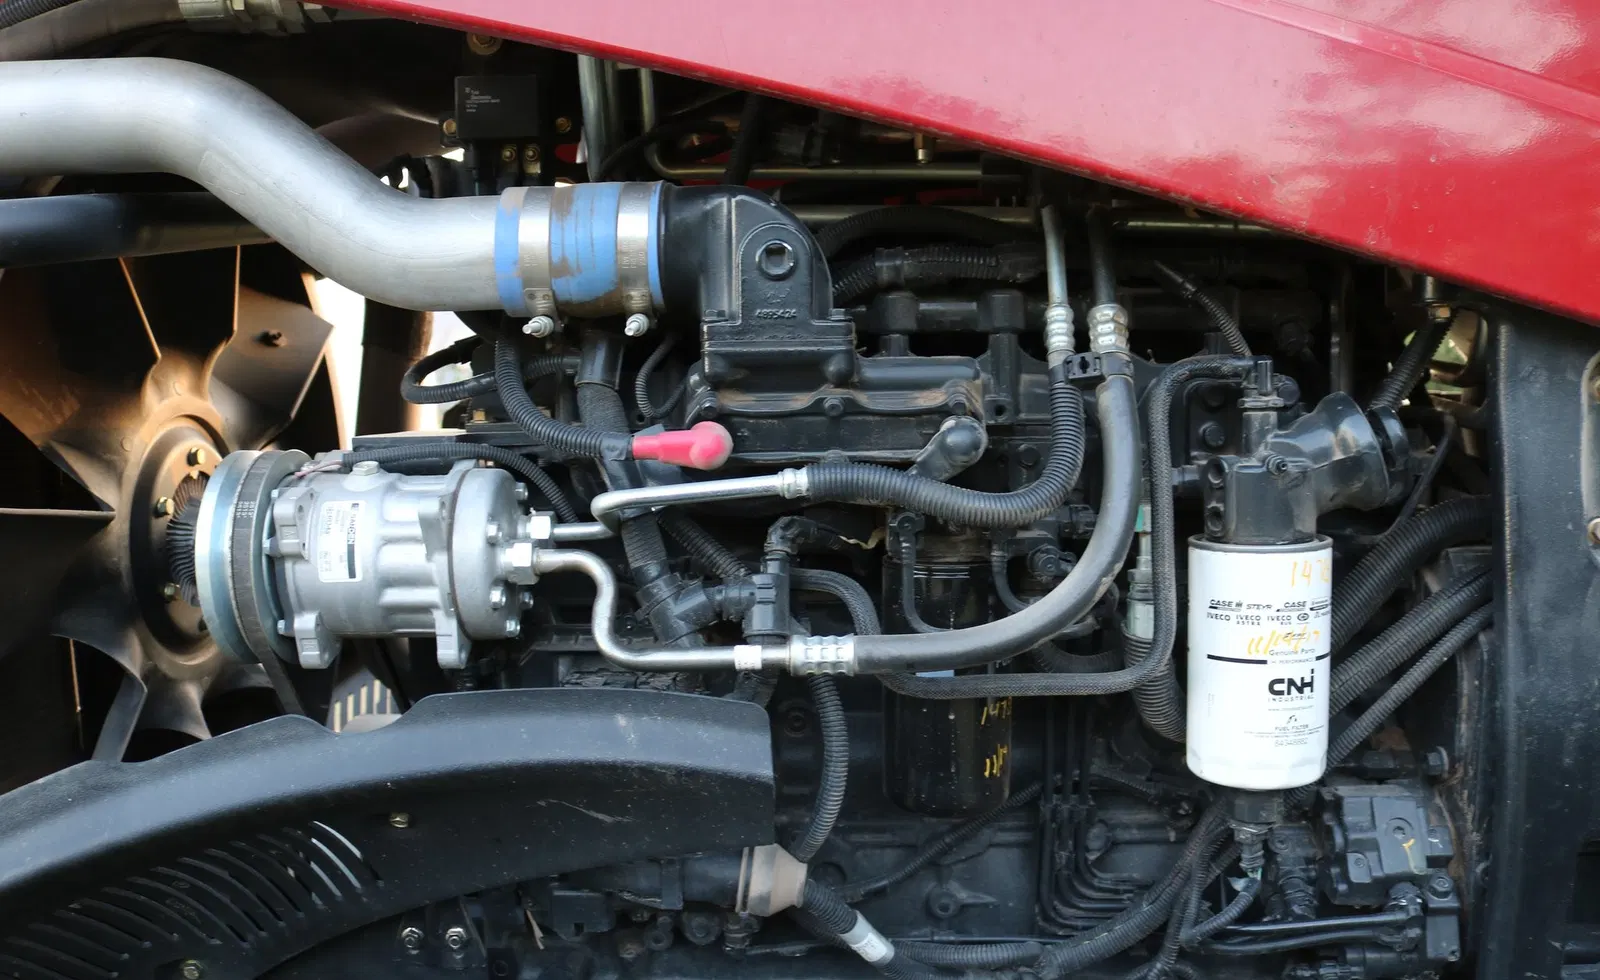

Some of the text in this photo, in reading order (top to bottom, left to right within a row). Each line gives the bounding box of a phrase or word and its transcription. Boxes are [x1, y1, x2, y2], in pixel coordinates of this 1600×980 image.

[1209, 599, 1234, 608] CASE
[1283, 600, 1307, 609] CASE
[1207, 612, 1231, 621] IVECO
